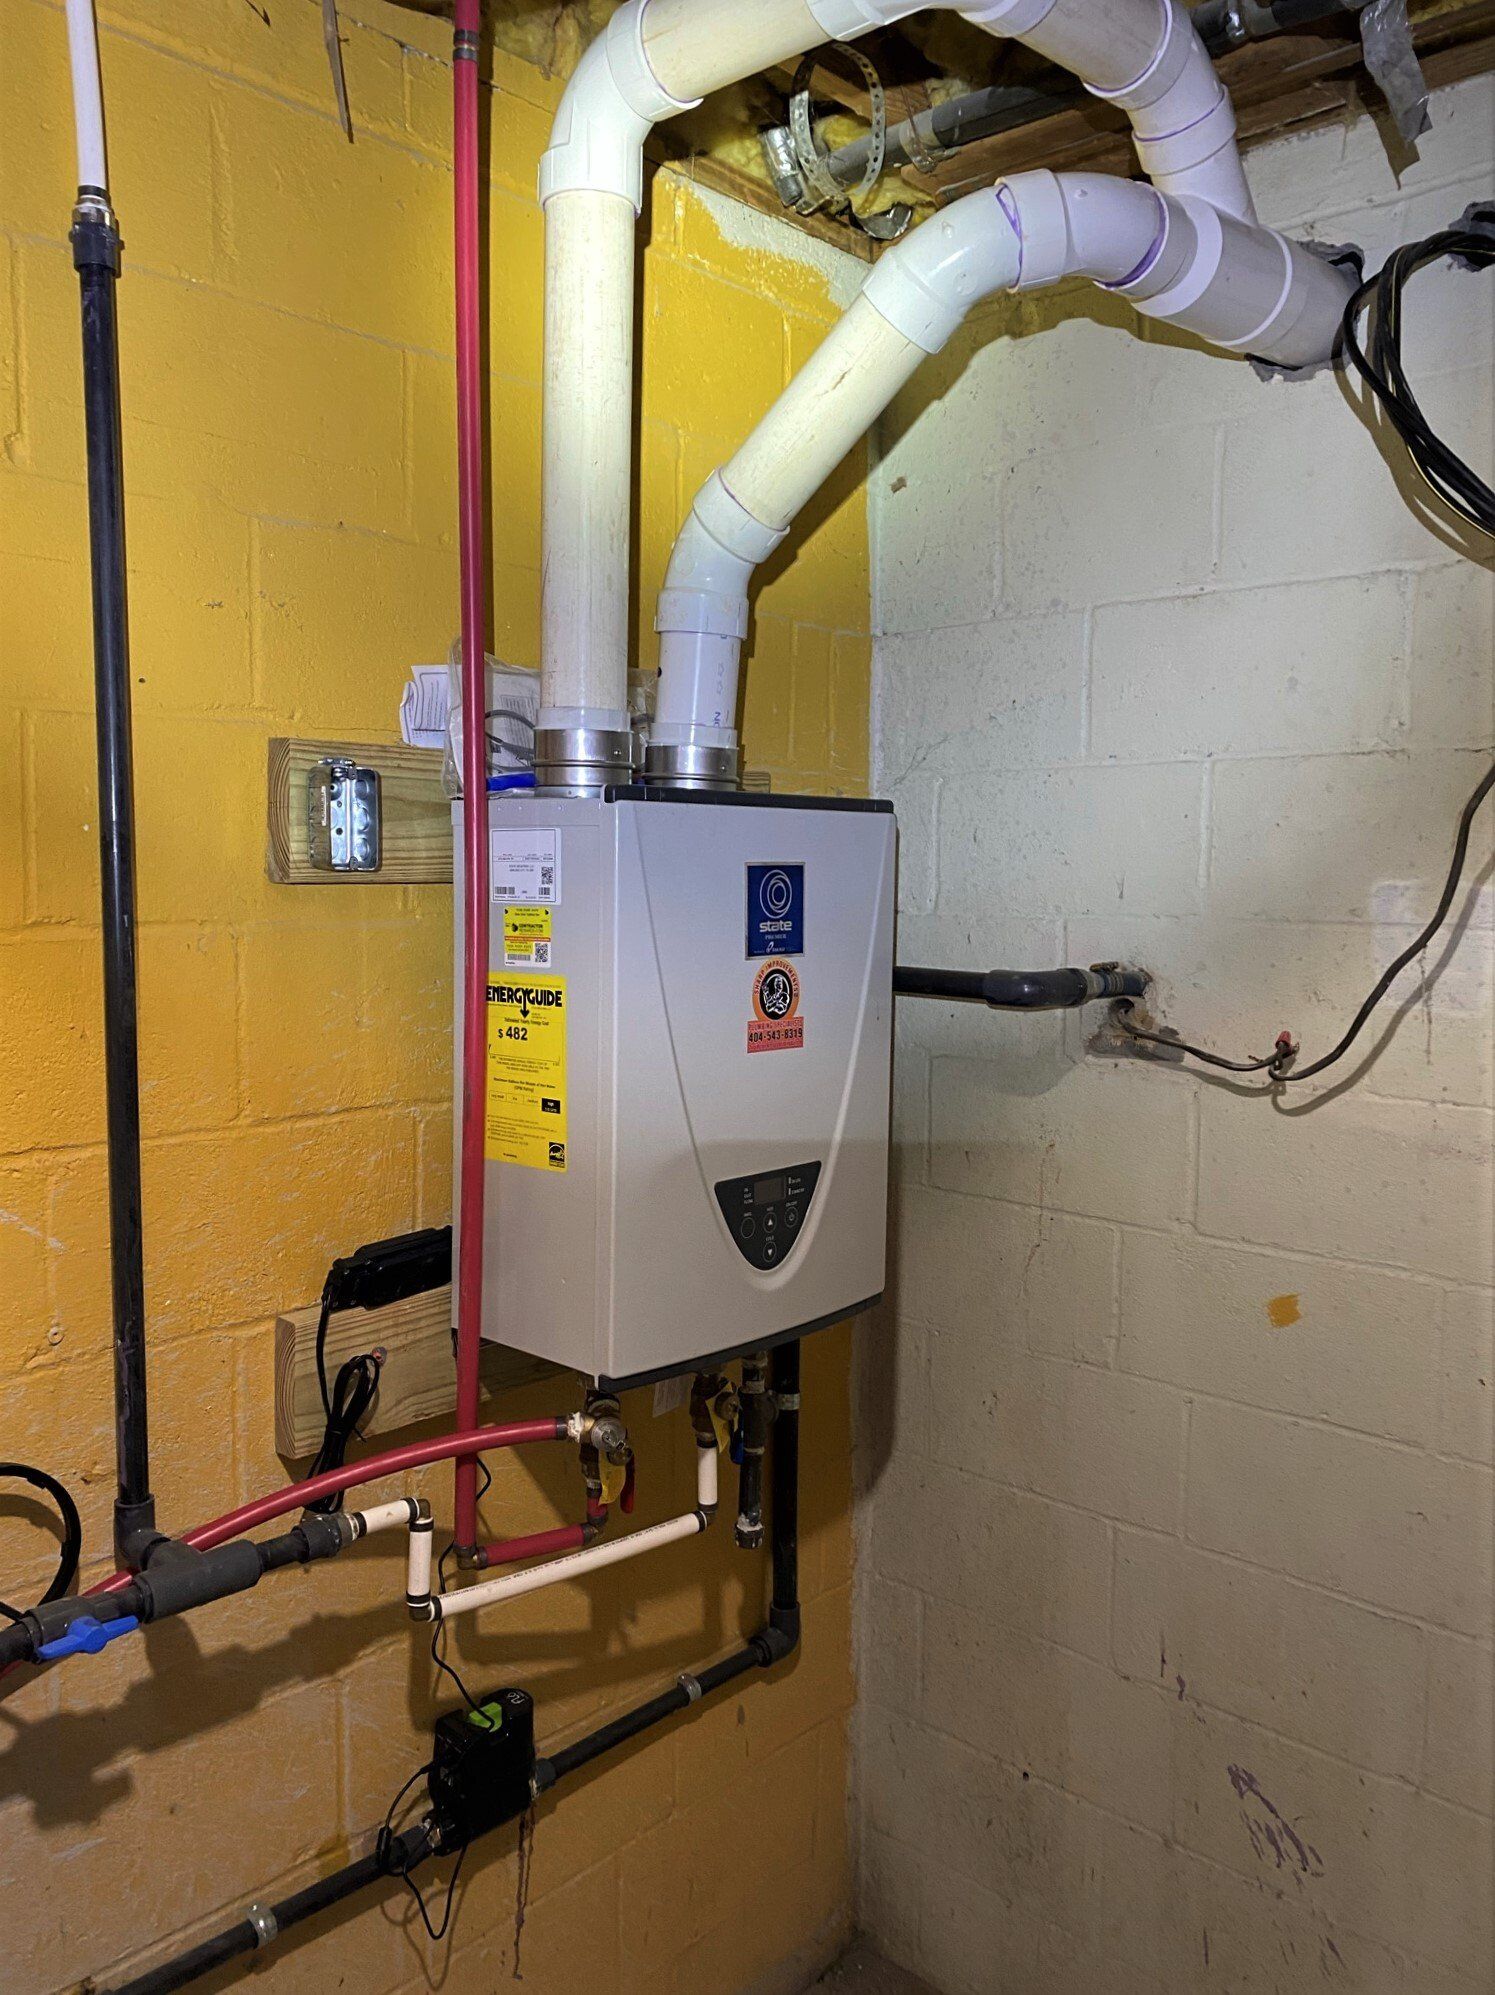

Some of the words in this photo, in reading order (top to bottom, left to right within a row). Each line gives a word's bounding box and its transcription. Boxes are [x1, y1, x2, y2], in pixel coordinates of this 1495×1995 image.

[759, 919, 793, 933] state
[486, 985, 563, 1008] ENERGYGUIDE
[506, 1026, 528, 1041] 482
